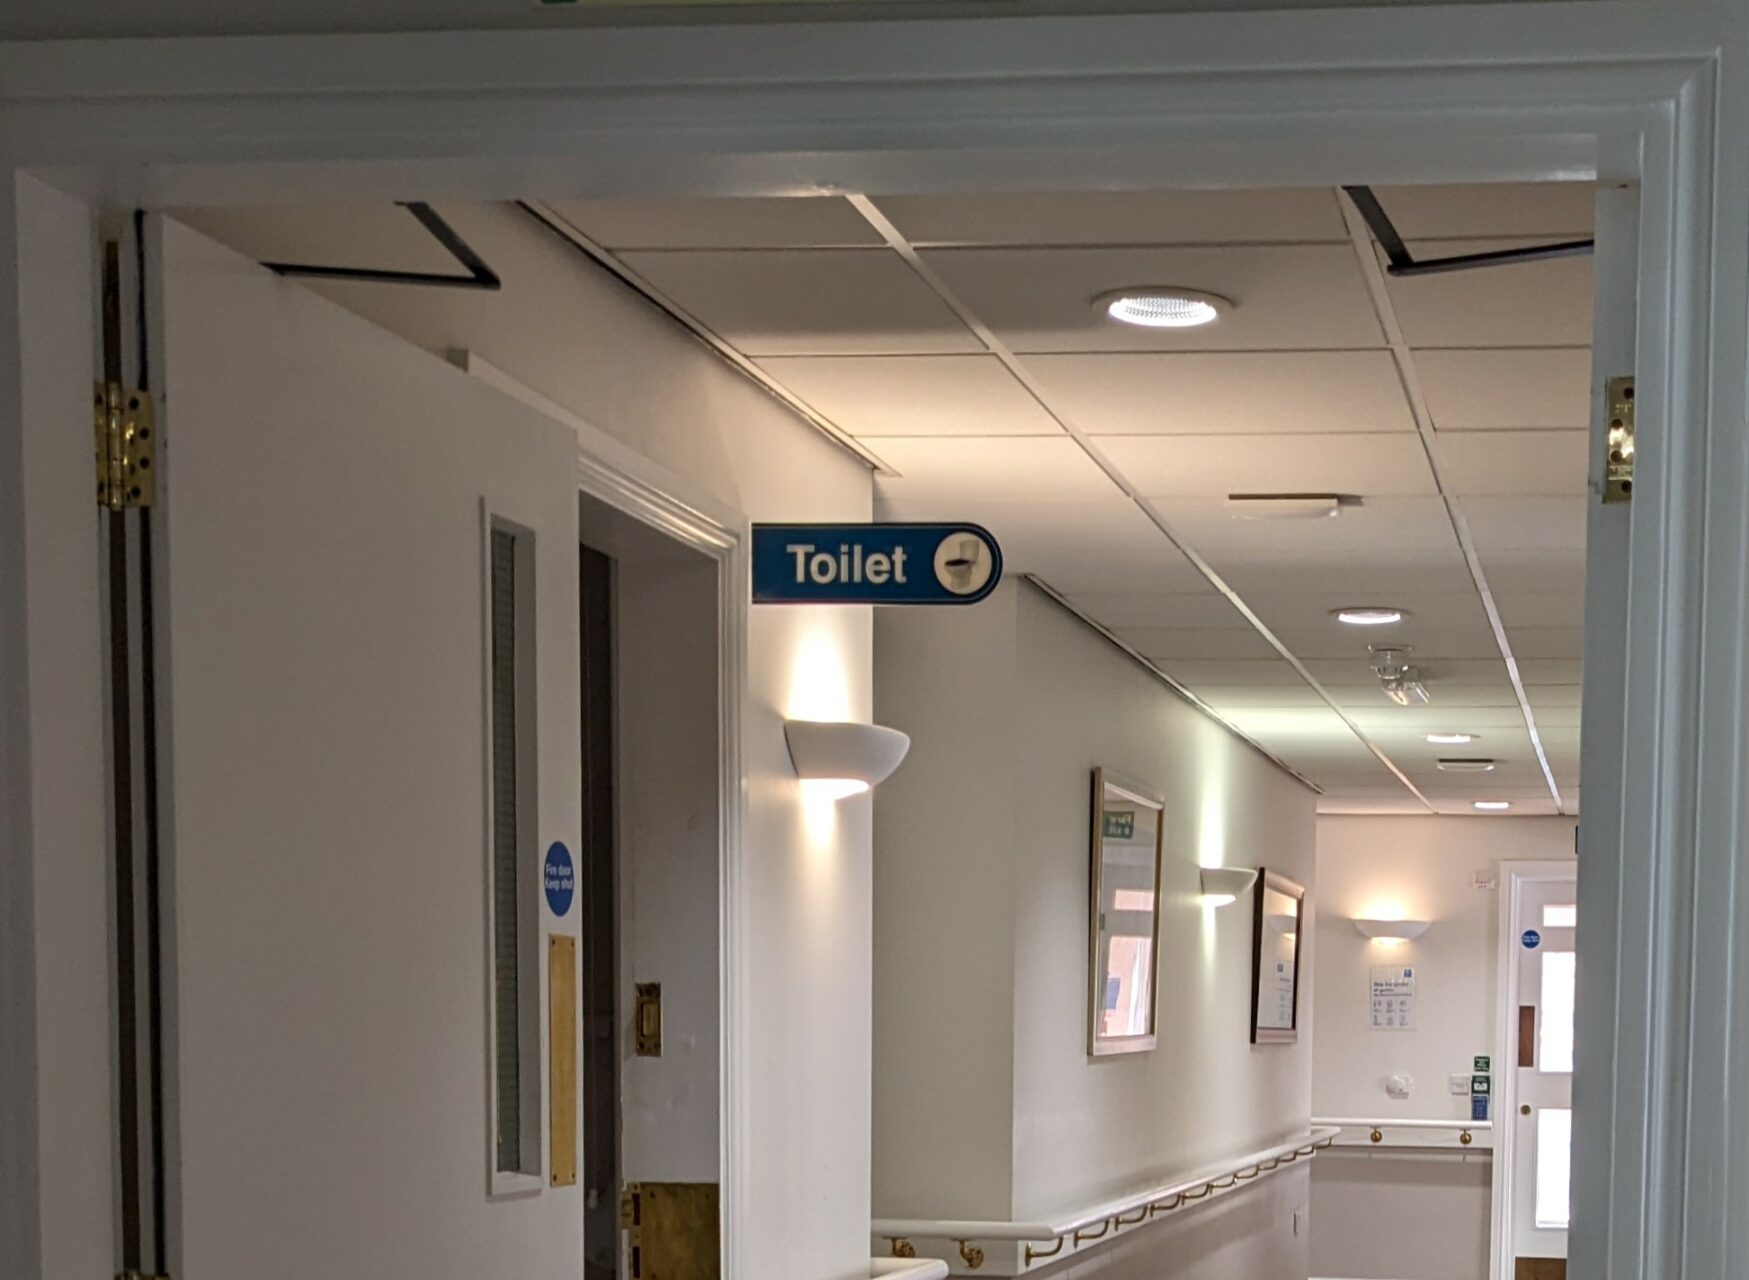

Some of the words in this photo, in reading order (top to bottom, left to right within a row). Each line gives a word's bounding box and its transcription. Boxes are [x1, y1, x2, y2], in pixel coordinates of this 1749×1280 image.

[786, 544, 907, 584] Toilet
[545, 863, 557, 876] Fire
[558, 864, 571, 876] door
